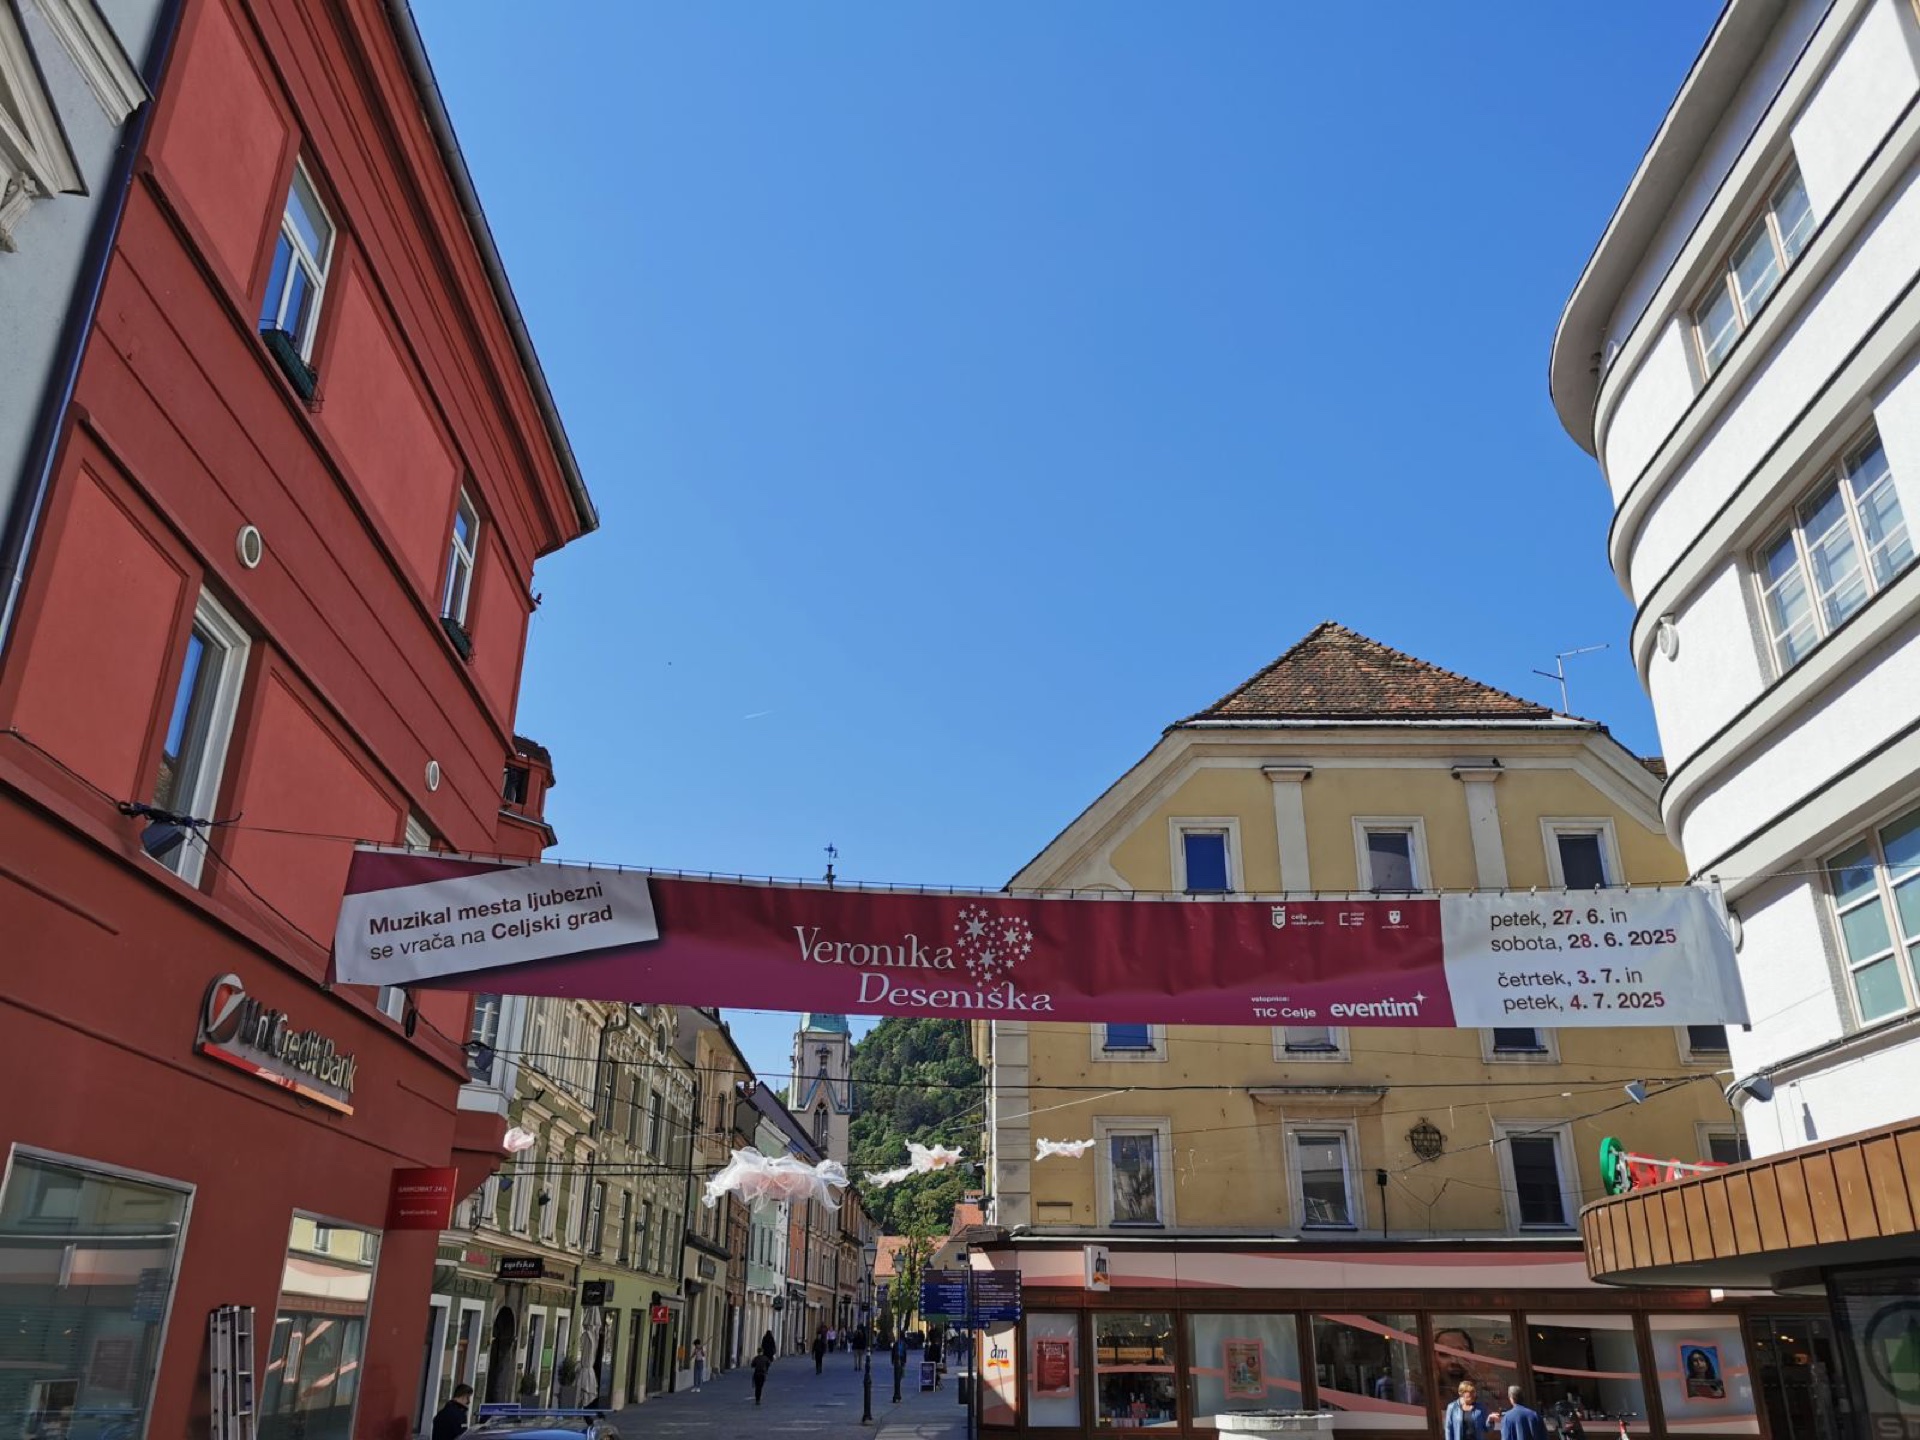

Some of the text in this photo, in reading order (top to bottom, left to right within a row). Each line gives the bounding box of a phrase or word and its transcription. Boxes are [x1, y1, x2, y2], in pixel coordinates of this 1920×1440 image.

[369, 881, 603, 935] Muzikal mesta ljubezni
[1490, 907, 1628, 931] petek, 27. 6. in
[370, 904, 613, 960] se vrača na Celjski grad
[1491, 929, 1677, 952] sobota, 28. 6. 2025
[793, 925, 956, 969] Veronika
[1497, 967, 1643, 987] četrtek, 3. 7. in
[856, 972, 1055, 1011] Deseniška
[1503, 991, 1666, 1014] petek, 4. 7. 2025
[1252, 1007, 1317, 1019] TIC Celje
[1330, 997, 1419, 1017] eventim
[1095, 1251, 1107, 1272] dm
[990, 1344, 1008, 1359] dm
